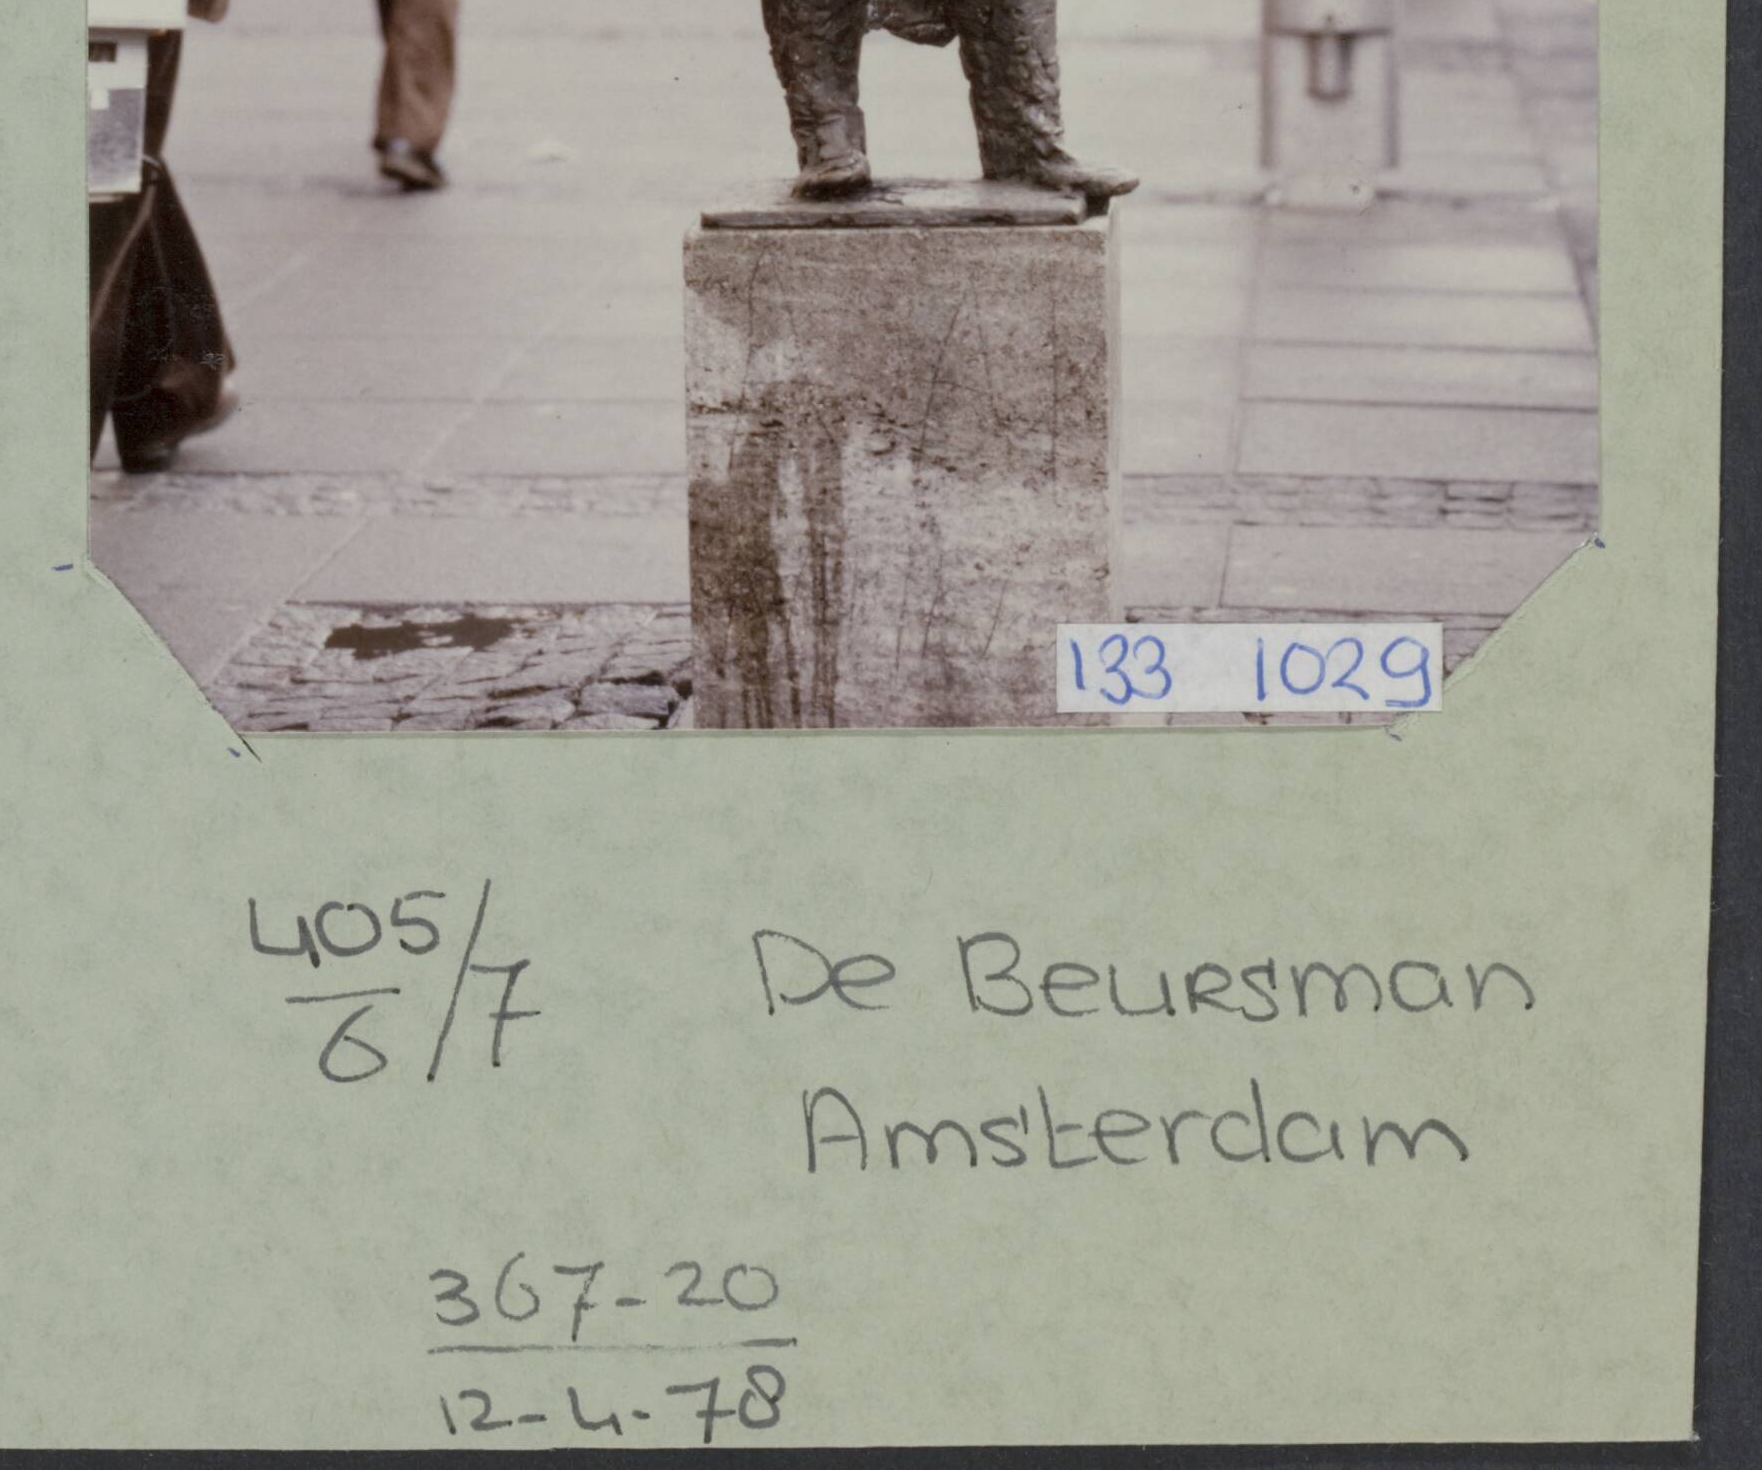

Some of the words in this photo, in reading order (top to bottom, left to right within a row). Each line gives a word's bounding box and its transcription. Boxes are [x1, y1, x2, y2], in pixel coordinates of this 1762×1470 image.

[1070, 633, 1172, 705] 133
[1256, 636, 1432, 708] 1029
[750, 929, 895, 1016] De
[802, 1078, 1469, 1173] Amsterdam
[429, 1252, 779, 1342] 367-20
[440, 1365, 786, 1442] 12-4-78
